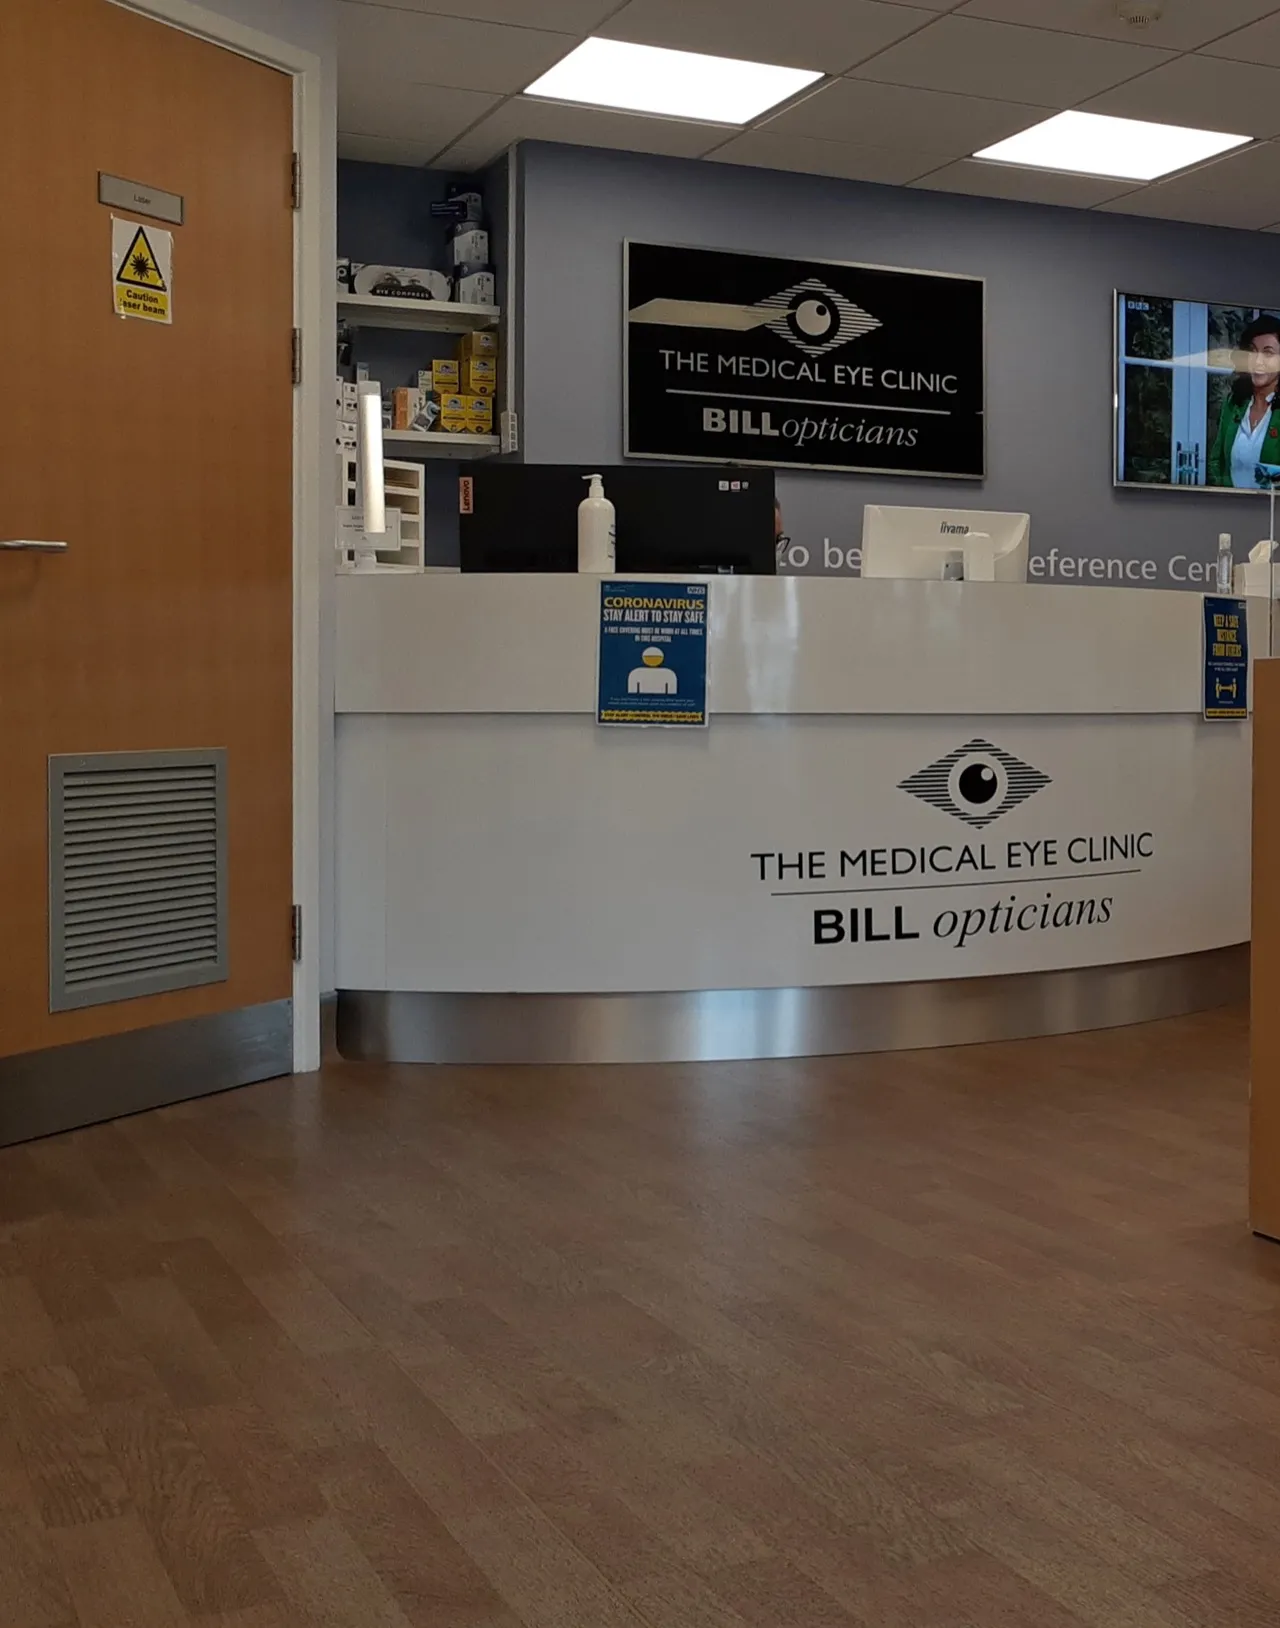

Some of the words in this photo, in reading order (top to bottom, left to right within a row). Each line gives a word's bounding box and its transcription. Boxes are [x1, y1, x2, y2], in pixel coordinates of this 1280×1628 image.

[126, 289, 159, 304] Caution
[143, 302, 166, 316] beam
[659, 349, 709, 374] THE
[717, 354, 826, 384] MEDICAL
[834, 364, 874, 388] EYE
[881, 369, 958, 394] CLINIC
[703, 407, 780, 437] BILL
[781, 415, 919, 447] opticians
[462, 480, 471, 511] Lenovo
[1029, 548, 1158, 580] eference
[1168, 554, 1218, 582] Cen
[604, 597, 704, 610] CORONAVIRUS
[688, 586, 705, 595] NHS
[603, 609, 624, 622] STAY
[624, 609, 649, 623] ALERT
[651, 610, 662, 623] TO
[663, 610, 683, 624] STAY
[684, 611, 704, 624] SAFE
[750, 850, 826, 881] THE
[839, 844, 997, 878] MEDICAL
[1007, 839, 1058, 869] EYE
[1067, 832, 1153, 864] CLINIC
[813, 905, 920, 945] BILL
[933, 892, 1114, 949] opticians
